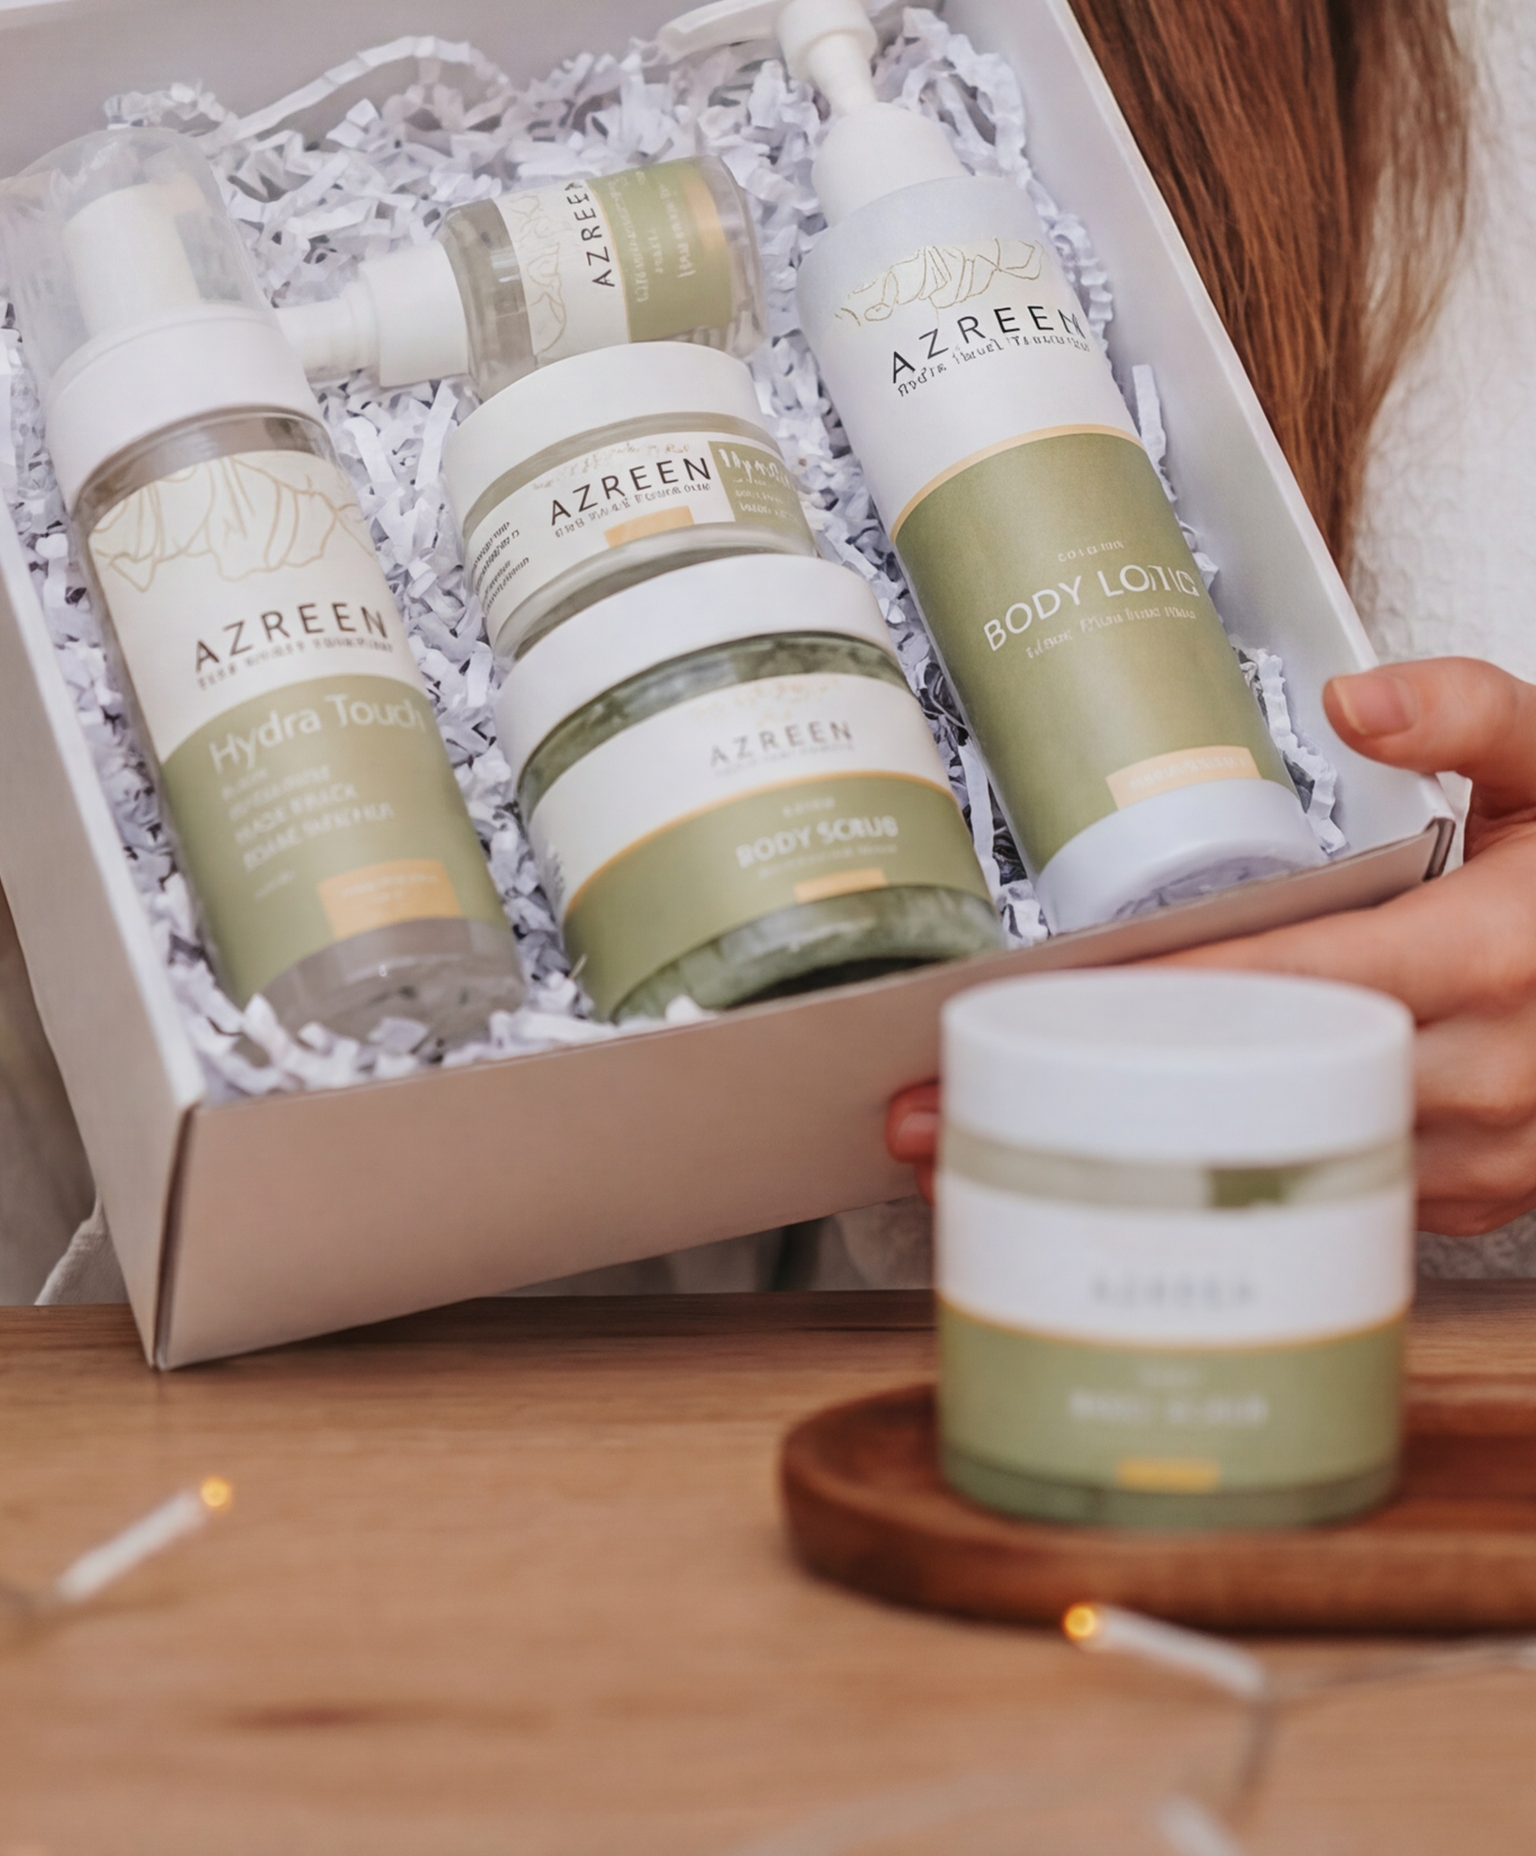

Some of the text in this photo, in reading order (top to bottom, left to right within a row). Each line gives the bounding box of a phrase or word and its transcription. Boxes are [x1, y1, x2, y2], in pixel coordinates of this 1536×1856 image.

[892, 305, 1085, 384] AZREEN
[551, 457, 711, 526] AZREEN
[195, 602, 389, 674] AZREEN
[983, 575, 1082, 652] BODY
[208, 707, 323, 776] Hydra
[710, 720, 853, 769] AZREEN
[735, 824, 812, 869] BODY
[816, 815, 899, 844] SCRUB
